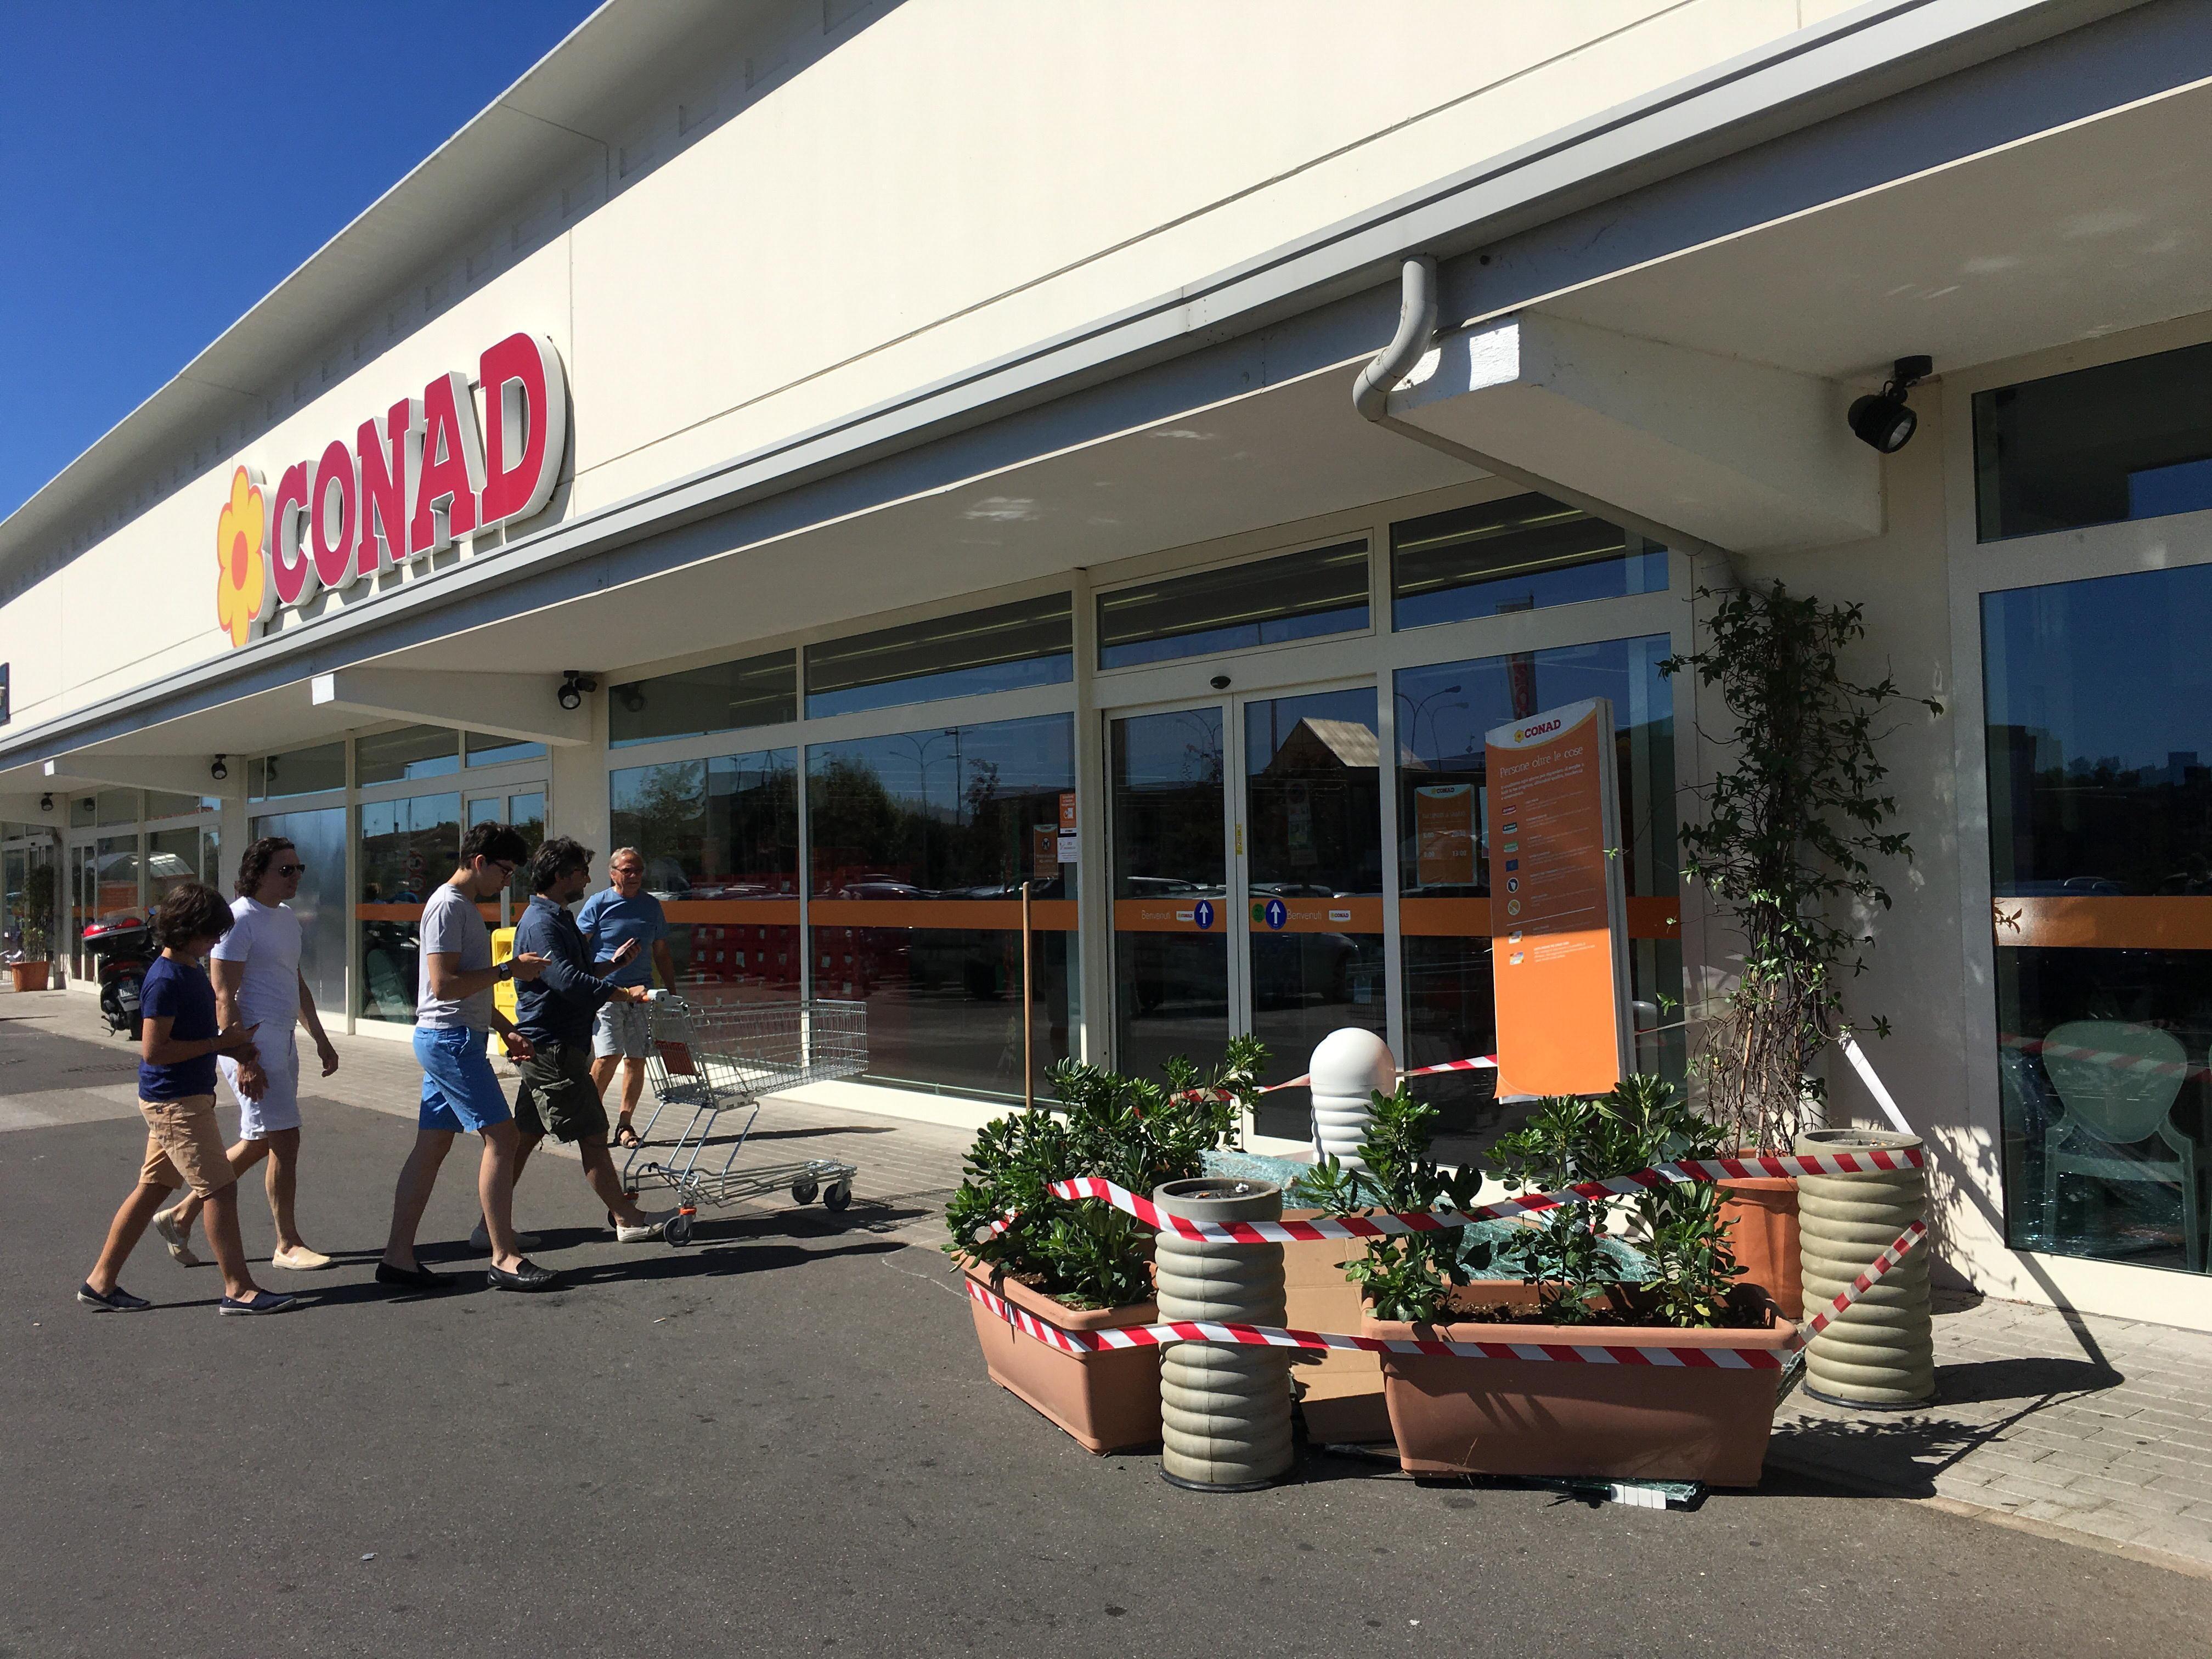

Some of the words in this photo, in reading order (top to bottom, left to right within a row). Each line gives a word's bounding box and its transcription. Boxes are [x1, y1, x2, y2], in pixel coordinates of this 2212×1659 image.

[272, 332, 557, 605] CONAD
[1525, 719, 1561, 738] CONAD
[1499, 762, 1530, 778] Persone
[1532, 755, 1551, 768] oltre
[1554, 751, 1561, 761] le
[1564, 747, 1583, 758] cose
[1286, 909, 1322, 919] Benvenuti
